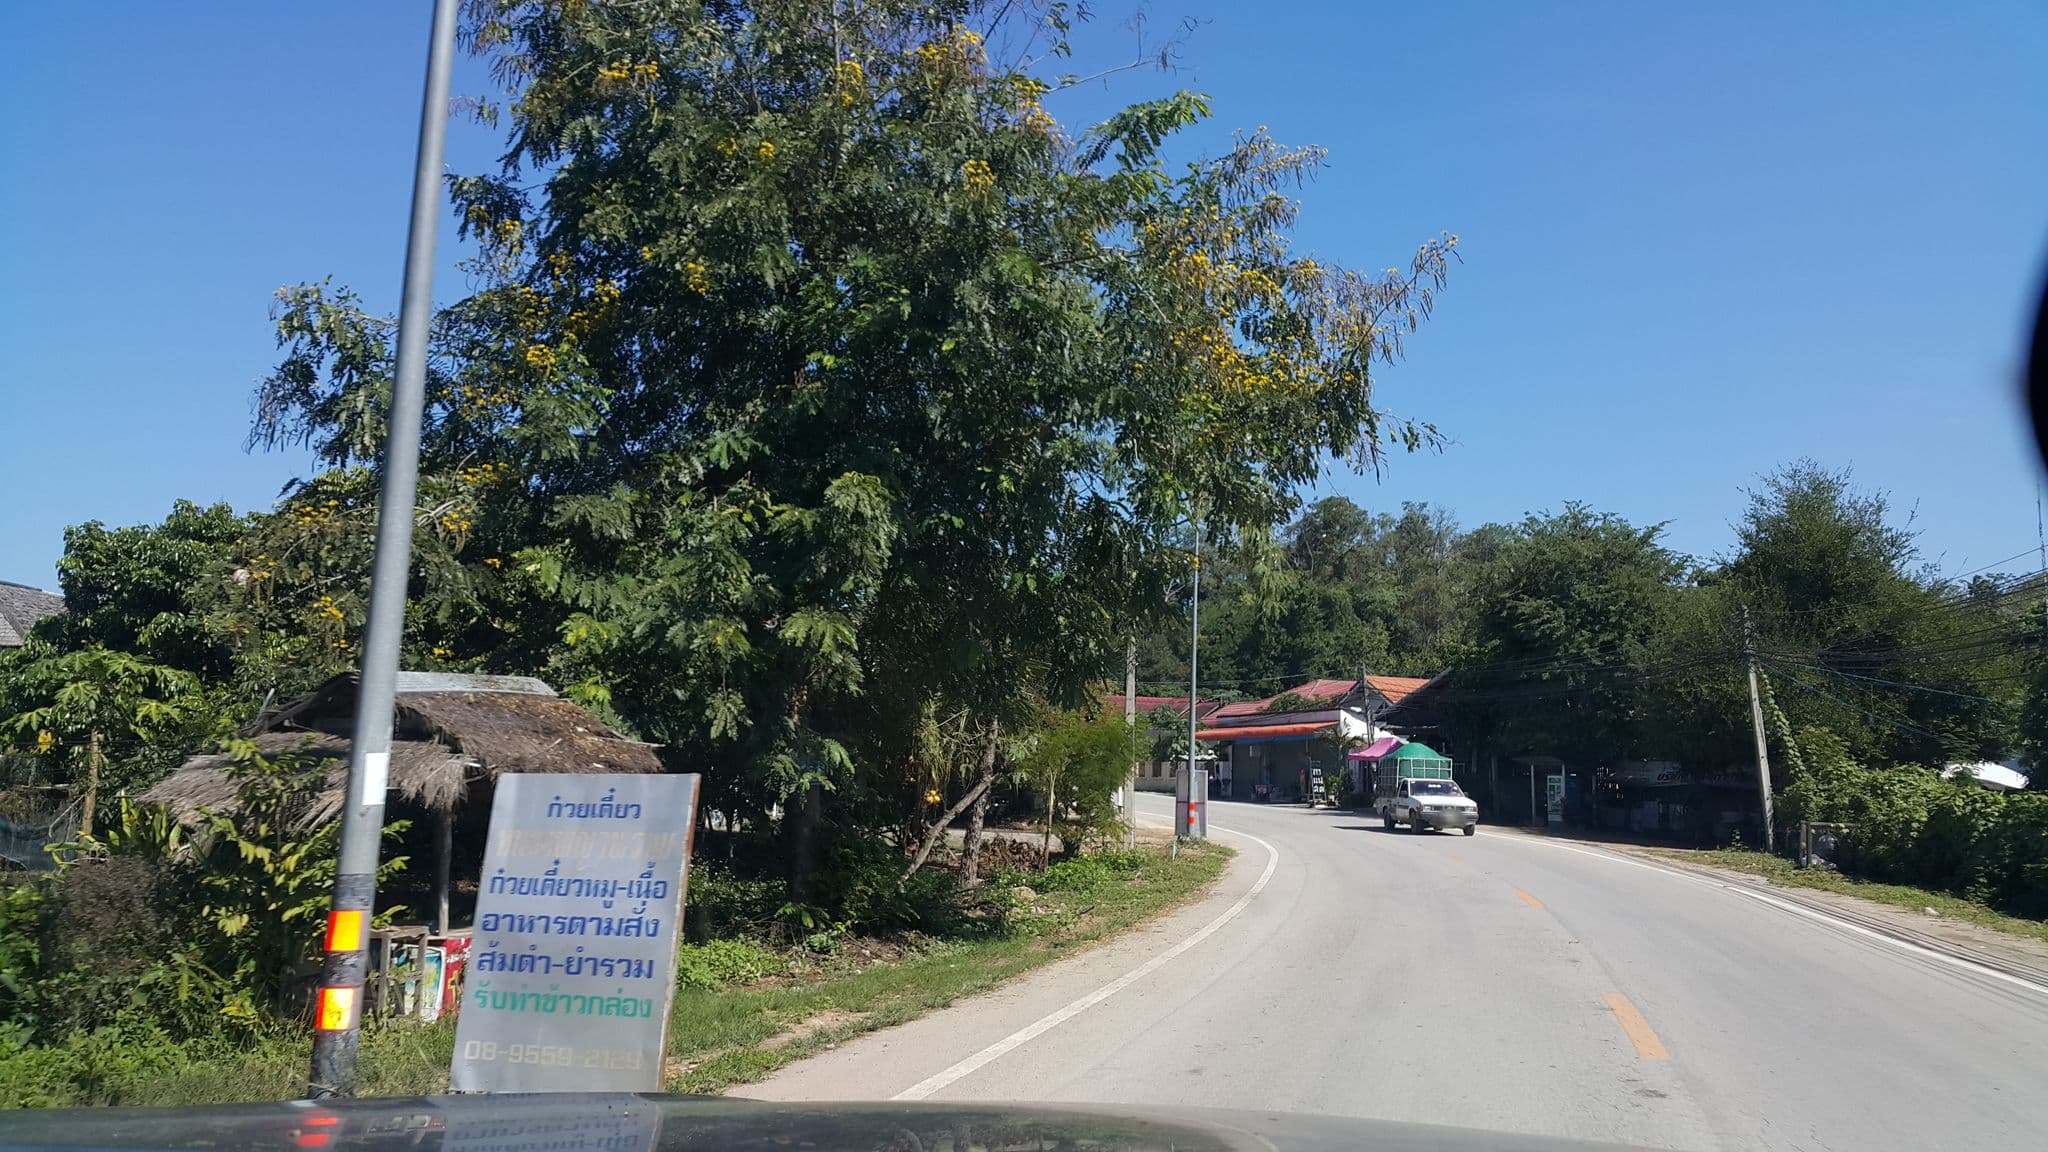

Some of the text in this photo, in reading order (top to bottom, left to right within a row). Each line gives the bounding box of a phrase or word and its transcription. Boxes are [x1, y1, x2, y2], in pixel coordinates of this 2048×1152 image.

[547, 788, 642, 819] ก๋วยเตี๋ยว
[476, 940, 654, 979] ส้มตำ-ยำรวม
[474, 979, 653, 1018] รับทำข้าวกล่อง
